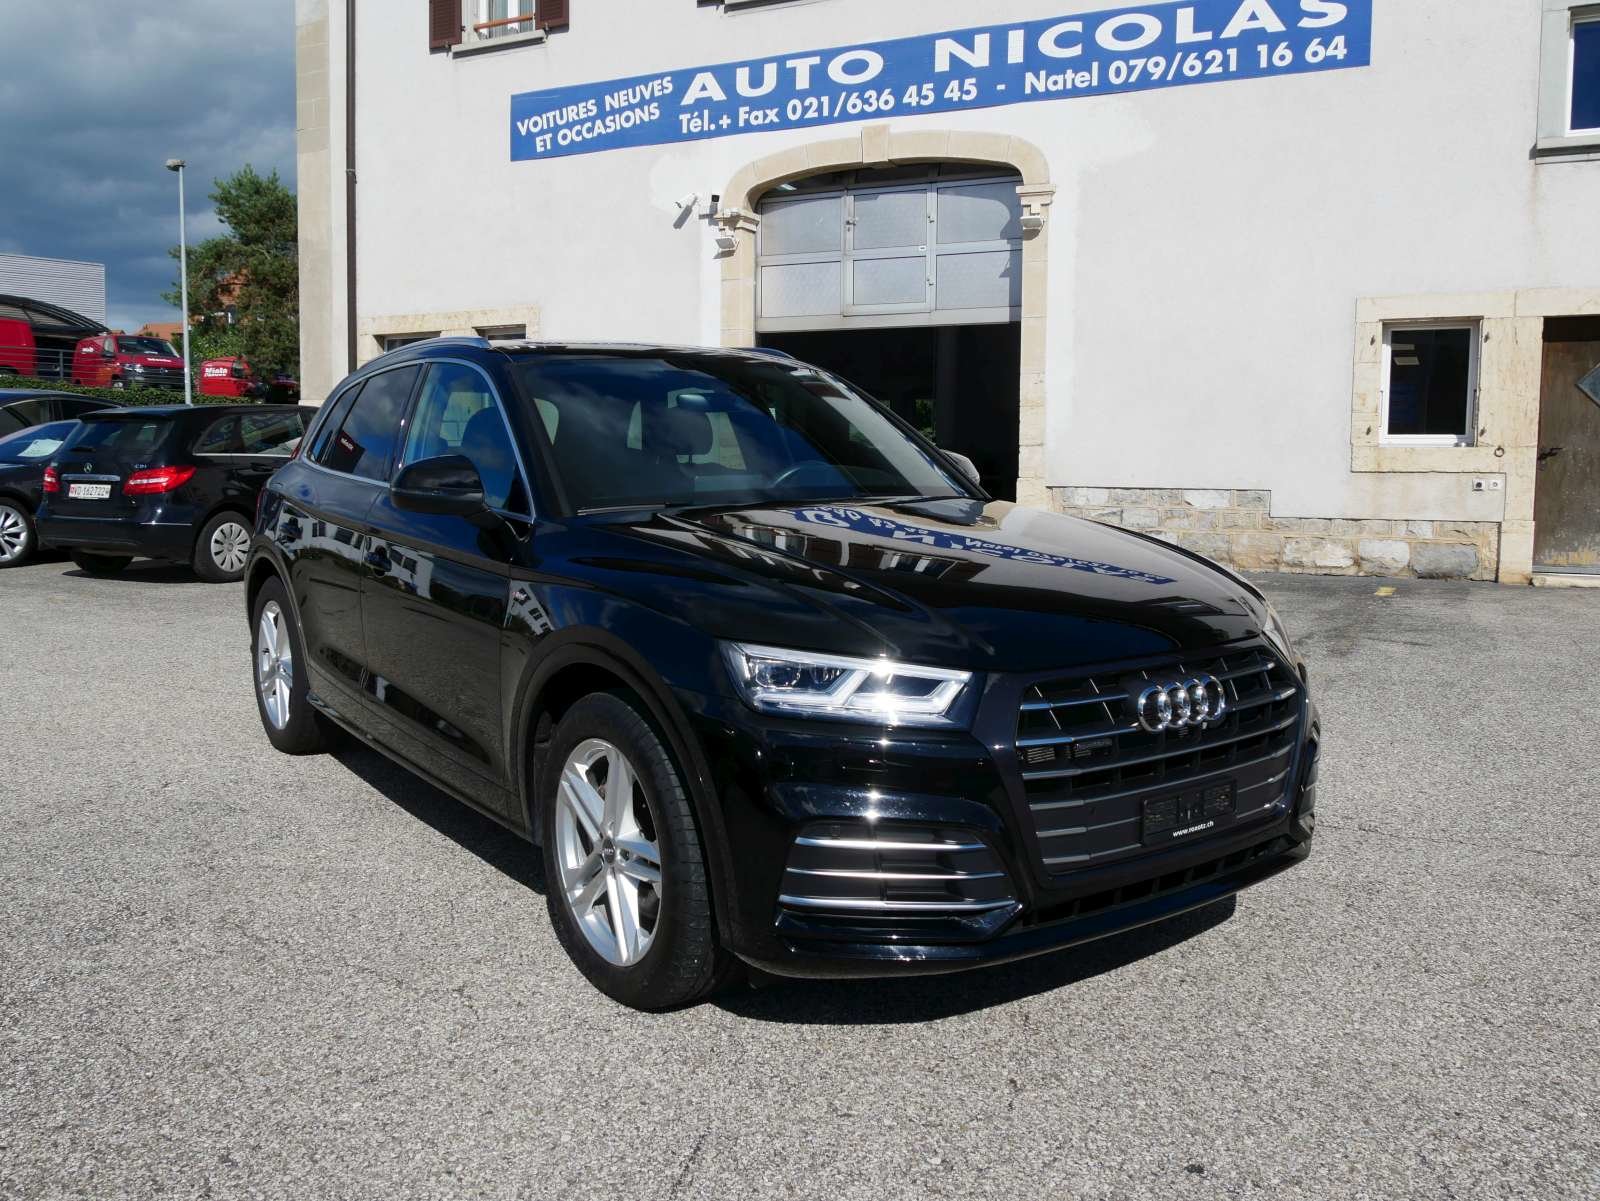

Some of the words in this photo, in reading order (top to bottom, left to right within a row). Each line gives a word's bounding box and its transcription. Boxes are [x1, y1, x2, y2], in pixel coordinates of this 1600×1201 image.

[681, 50, 883, 106] AUTO
[934, 0, 1348, 73] NICOLAS
[738, 106, 780, 127] Fax
[786, 88, 895, 121] 021/636
[903, 84, 935, 107] 45
[944, 77, 978, 102] 45
[1024, 62, 1099, 94] Natel
[1109, 48, 1238, 85] 079/621
[1257, 41, 1293, 69] 16
[1304, 35, 1348, 63] 64
[517, 98, 598, 136] VOITURES
[605, 76, 673, 110] NEUVES
[535, 132, 554, 153] ET
[557, 102, 661, 146] OCCASIONS
